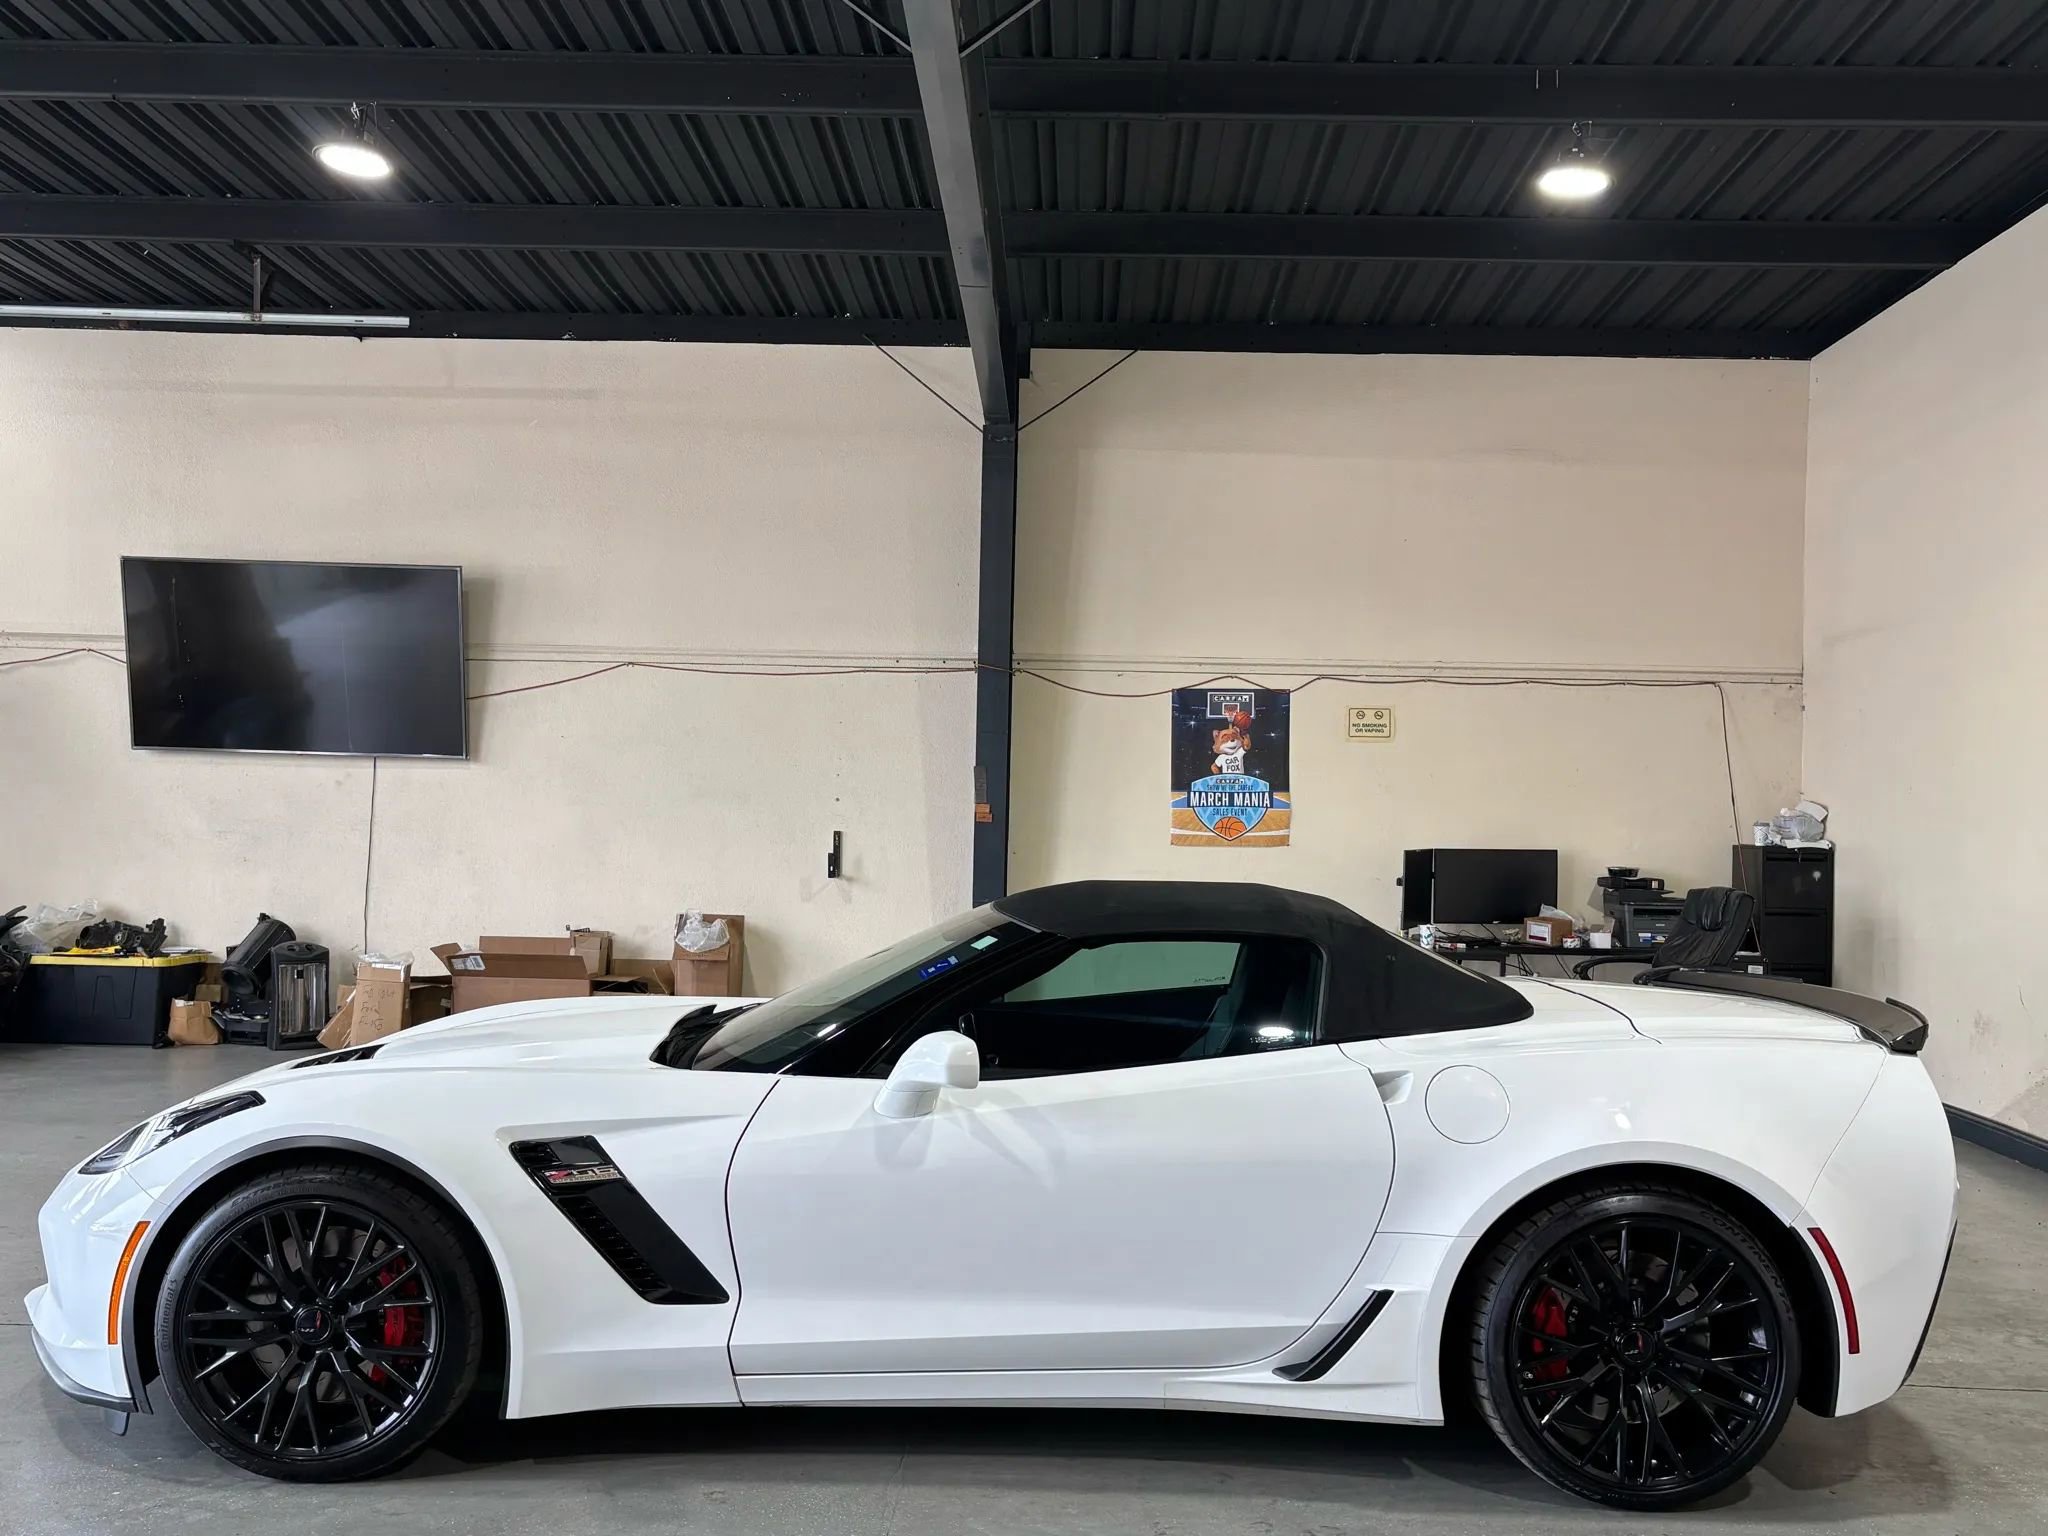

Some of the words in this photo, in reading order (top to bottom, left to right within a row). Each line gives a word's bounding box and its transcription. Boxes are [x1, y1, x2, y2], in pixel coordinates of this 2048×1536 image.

[1225, 756, 1239, 765] CAR
[1226, 764, 1240, 772] FOX
[1190, 792, 1229, 807] MARCH
[1234, 792, 1271, 807] MANIA
[1212, 808, 1229, 816] SALES
[1231, 808, 1247, 816] EVENT
[160, 1286, 176, 1352] Continental
